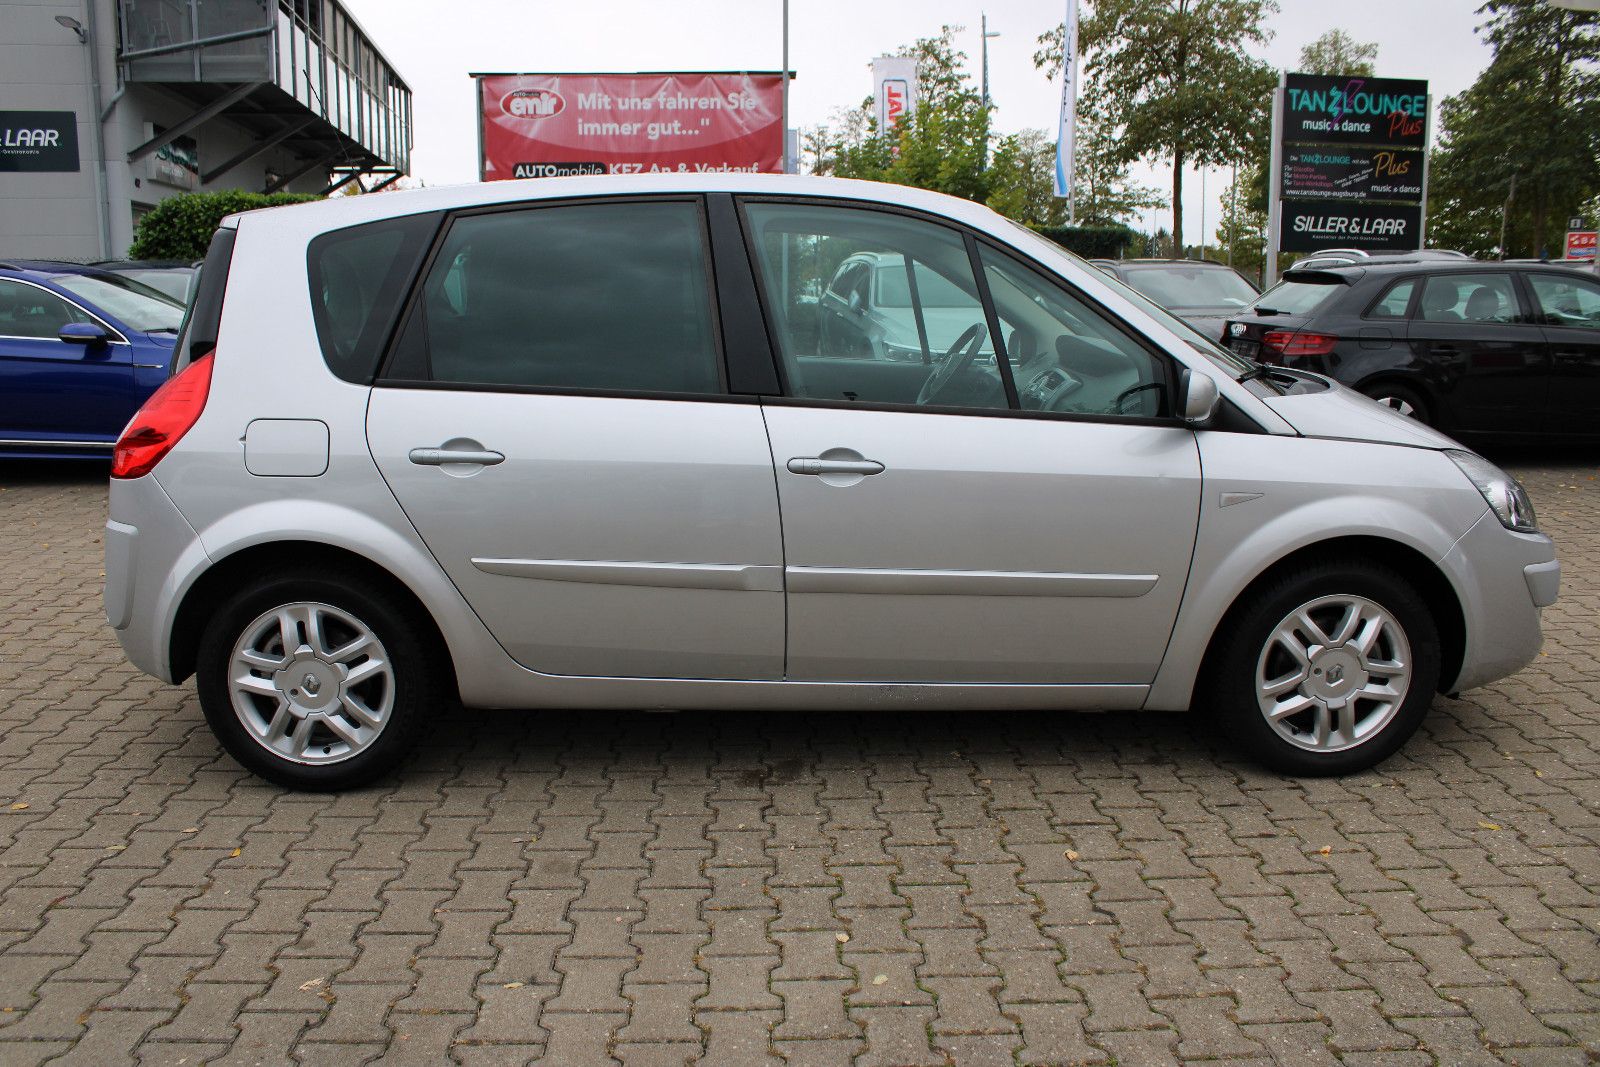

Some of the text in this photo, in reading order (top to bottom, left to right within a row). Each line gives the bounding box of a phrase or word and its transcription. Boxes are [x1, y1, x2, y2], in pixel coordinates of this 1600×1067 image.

[510, 93, 557, 116] emir
[578, 91, 756, 111] Mit uns fahren Sie
[1288, 86, 1425, 117] TANZLOUNGE
[577, 118, 710, 140] immer gut..."
[1302, 119, 1371, 133] music & dance
[1387, 110, 1423, 138] Plus
[5, 129, 59, 147] LAAR
[515, 164, 603, 177] AUTOmobile
[695, 162, 759, 173] Verkauf
[1373, 152, 1410, 177] Plus
[1371, 184, 1391, 192] music
[1399, 184, 1421, 193] dance
[1293, 215, 1407, 235] SILLER & LAAR
